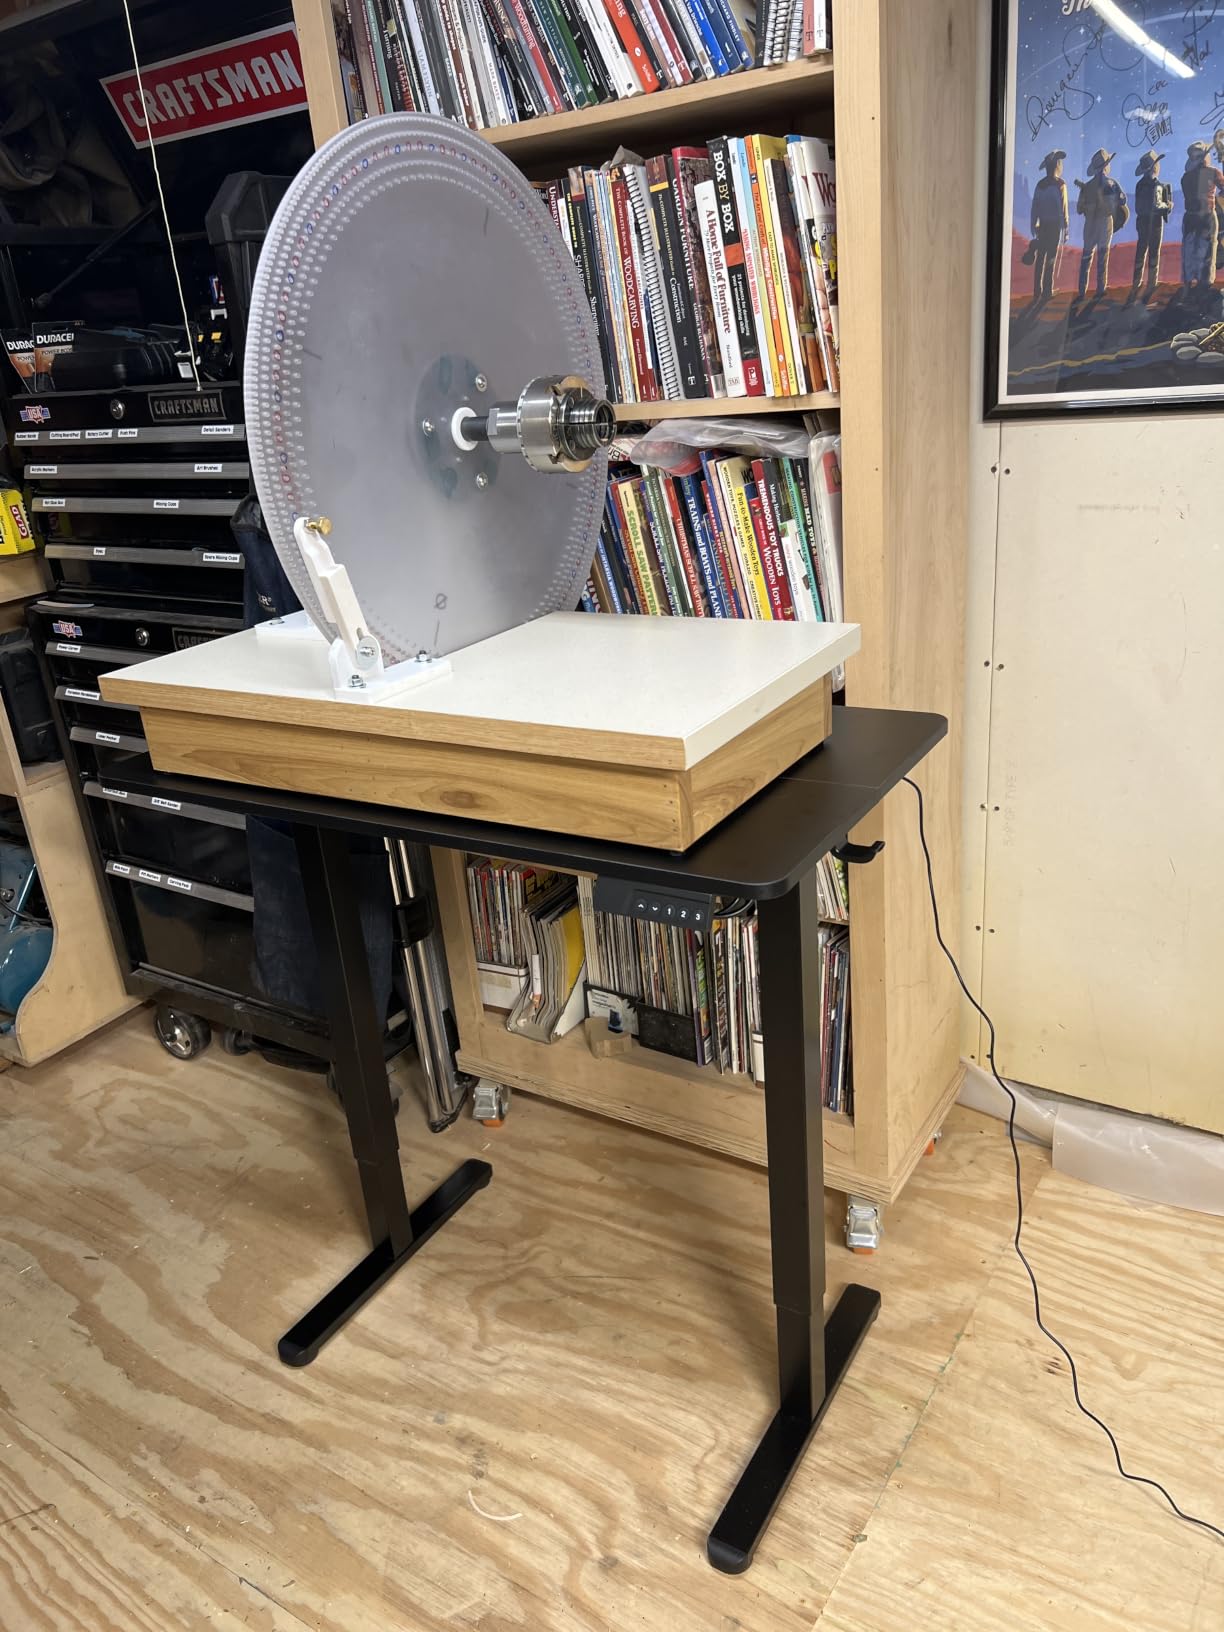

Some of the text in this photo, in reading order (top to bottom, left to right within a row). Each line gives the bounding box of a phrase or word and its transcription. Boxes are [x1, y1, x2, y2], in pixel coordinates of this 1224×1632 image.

[513, 2, 536, 49] Woodturning
[122, 49, 303, 128] CRAFTSMAN
[549, 186, 560, 229] UNDERSTA
[712, 150, 735, 232] BOX BY BOX
[671, 178, 694, 289] GARDEN FURNITURE
[616, 200, 625, 229] COMPLETE
[622, 256, 640, 328] WOODCARVING
[704, 209, 732, 334] A Home Full of Furniture
[669, 277, 683, 323] Construction
[7, 339, 35, 351] DURAC
[36, 332, 75, 345] DURACE
[27, 407, 42, 419] USA
[154, 399, 219, 415] CRAFTSMAN
[722, 466, 731, 489] WOODEN
[731, 504, 739, 525] PUZZLES
[789, 490, 800, 528] CONSTRUCTION
[804, 507, 812, 525] MAD
[12, 506, 28, 537] GLAD
[626, 510, 641, 548] SCROLL
[636, 549, 647, 572] SAW
[675, 517, 690, 557] CHRISTMAS
[736, 492, 760, 575] Fun-to-Make Wooden Toys
[757, 478, 784, 576] TREMENDOUS TOY TRUCKS
[807, 526, 816, 546] TOYS
[687, 496, 722, 618] TRAINS and BOATS and PLANE
[762, 546, 782, 605] WOODEN TOYS
[608, 581, 621, 613] WOODWORK
[749, 580, 758, 603] CREATIVE
[60, 622, 74, 635] USA
